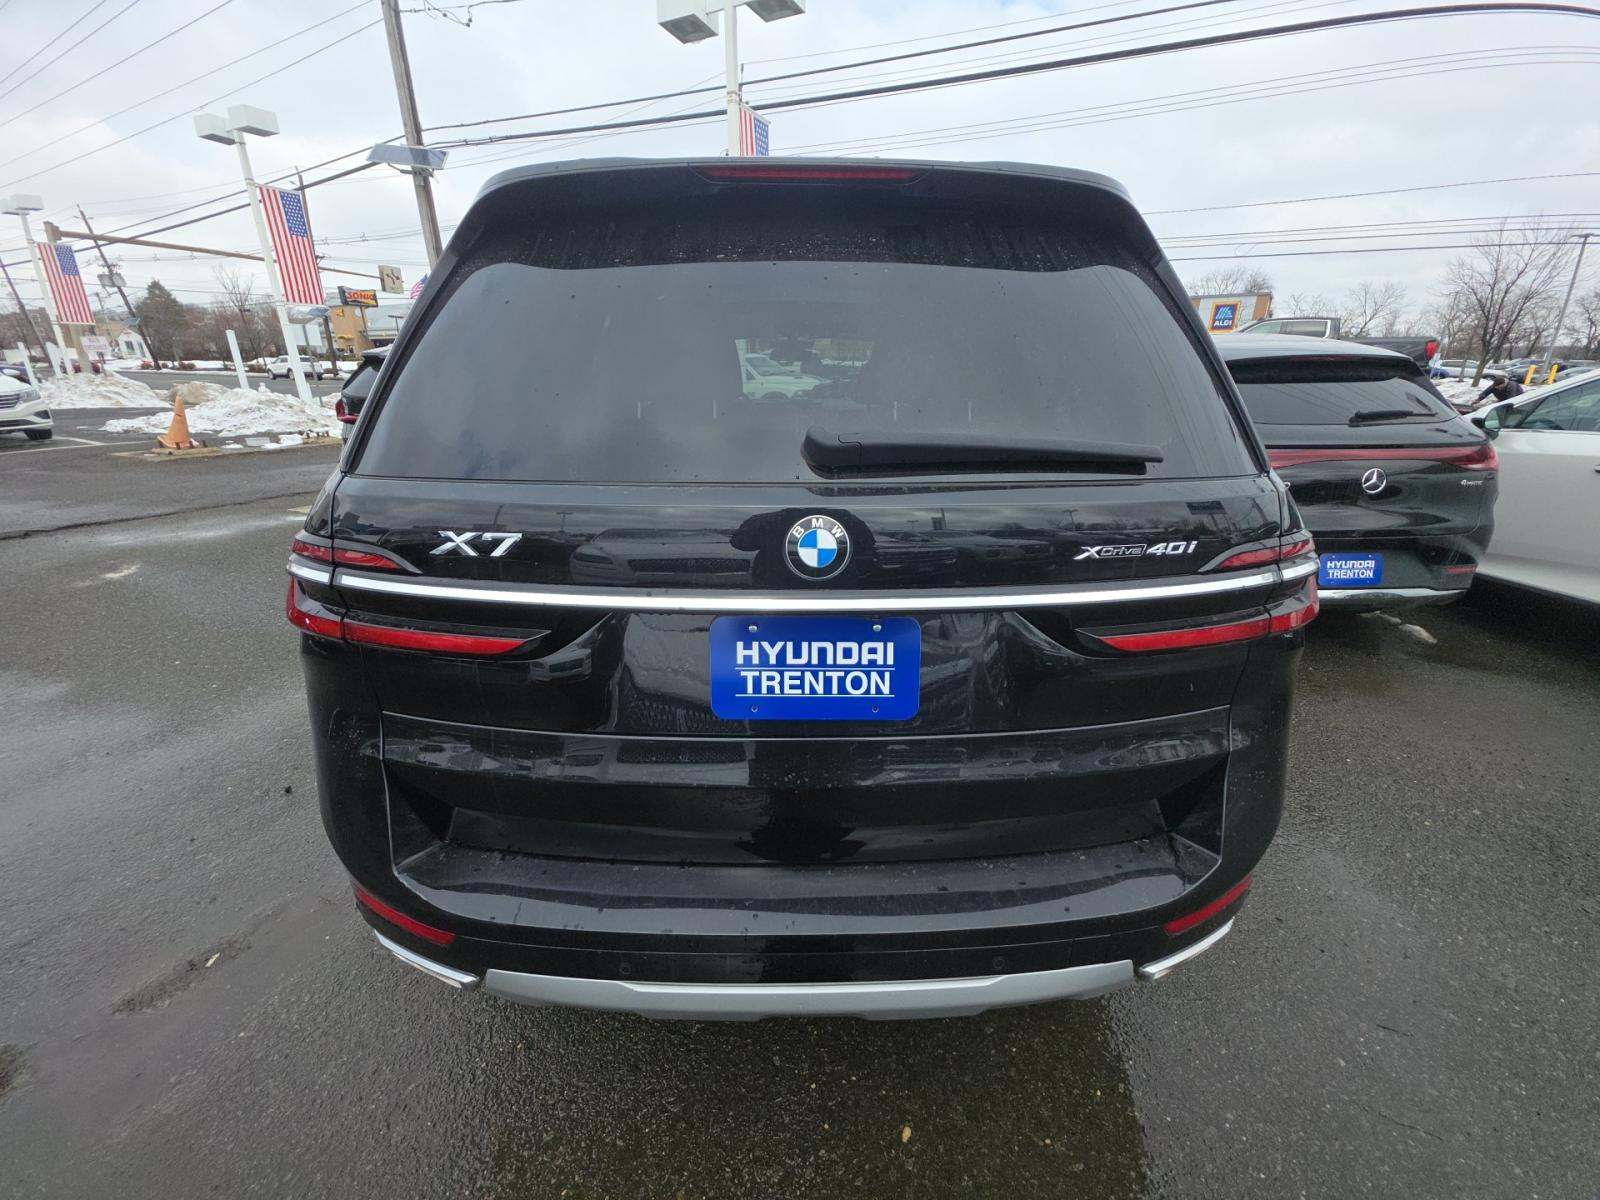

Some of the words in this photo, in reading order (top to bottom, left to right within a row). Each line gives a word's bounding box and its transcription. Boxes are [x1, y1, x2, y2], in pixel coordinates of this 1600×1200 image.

[347, 291, 374, 300] SONIC
[1214, 319, 1233, 327] ALDI
[792, 517, 845, 539] BMW
[429, 530, 523, 557] X7
[1326, 559, 1375, 569] HYUNDAI
[1327, 569, 1374, 579] TRENTON
[735, 640, 895, 666] HYUNDAI
[740, 670, 891, 695] TRENTON
